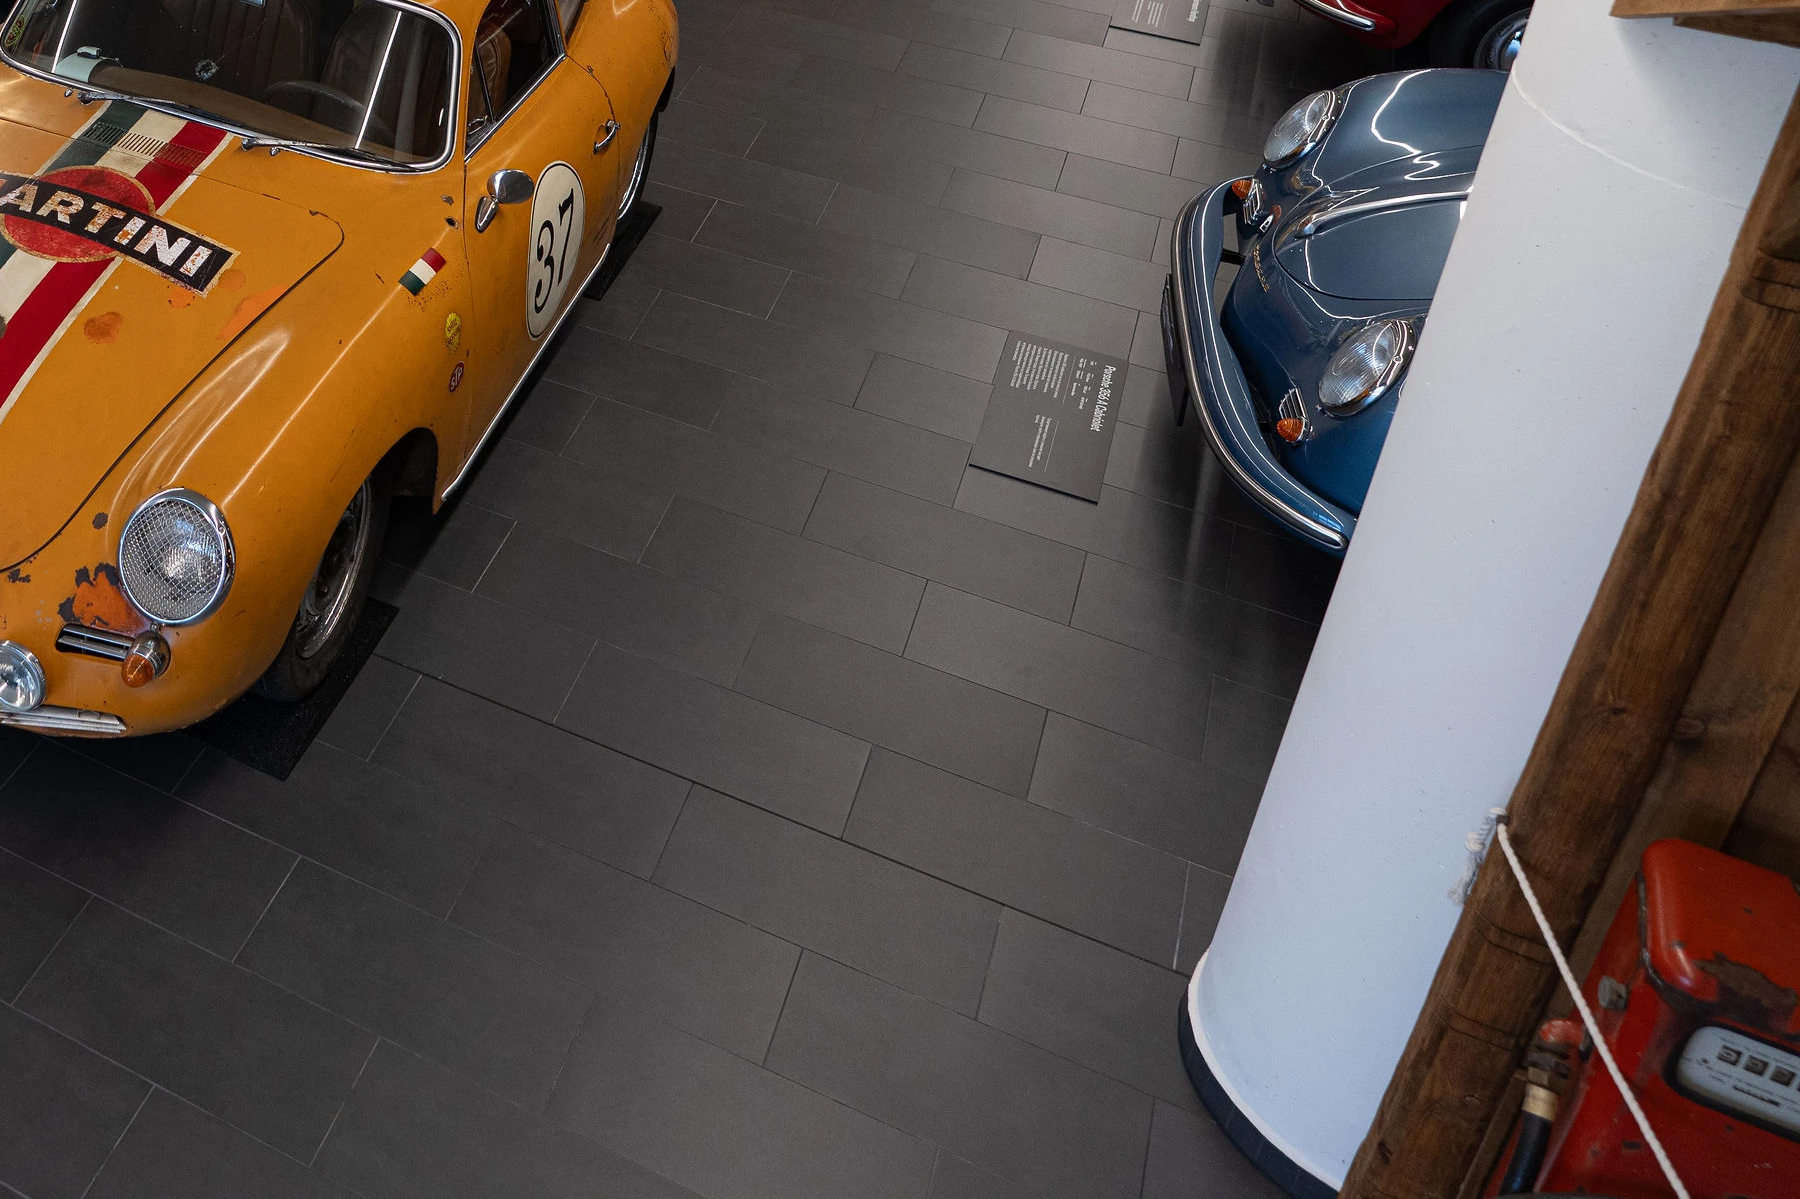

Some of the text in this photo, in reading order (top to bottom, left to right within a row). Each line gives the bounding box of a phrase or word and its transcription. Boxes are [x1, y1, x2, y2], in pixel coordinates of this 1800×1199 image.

[534, 187, 576, 315] 37
[450, 364, 464, 391] STP
[1100, 364, 1117, 388] Porsche
[1097, 387, 1112, 401] 356
[1090, 405, 1107, 433] Cabriolet
